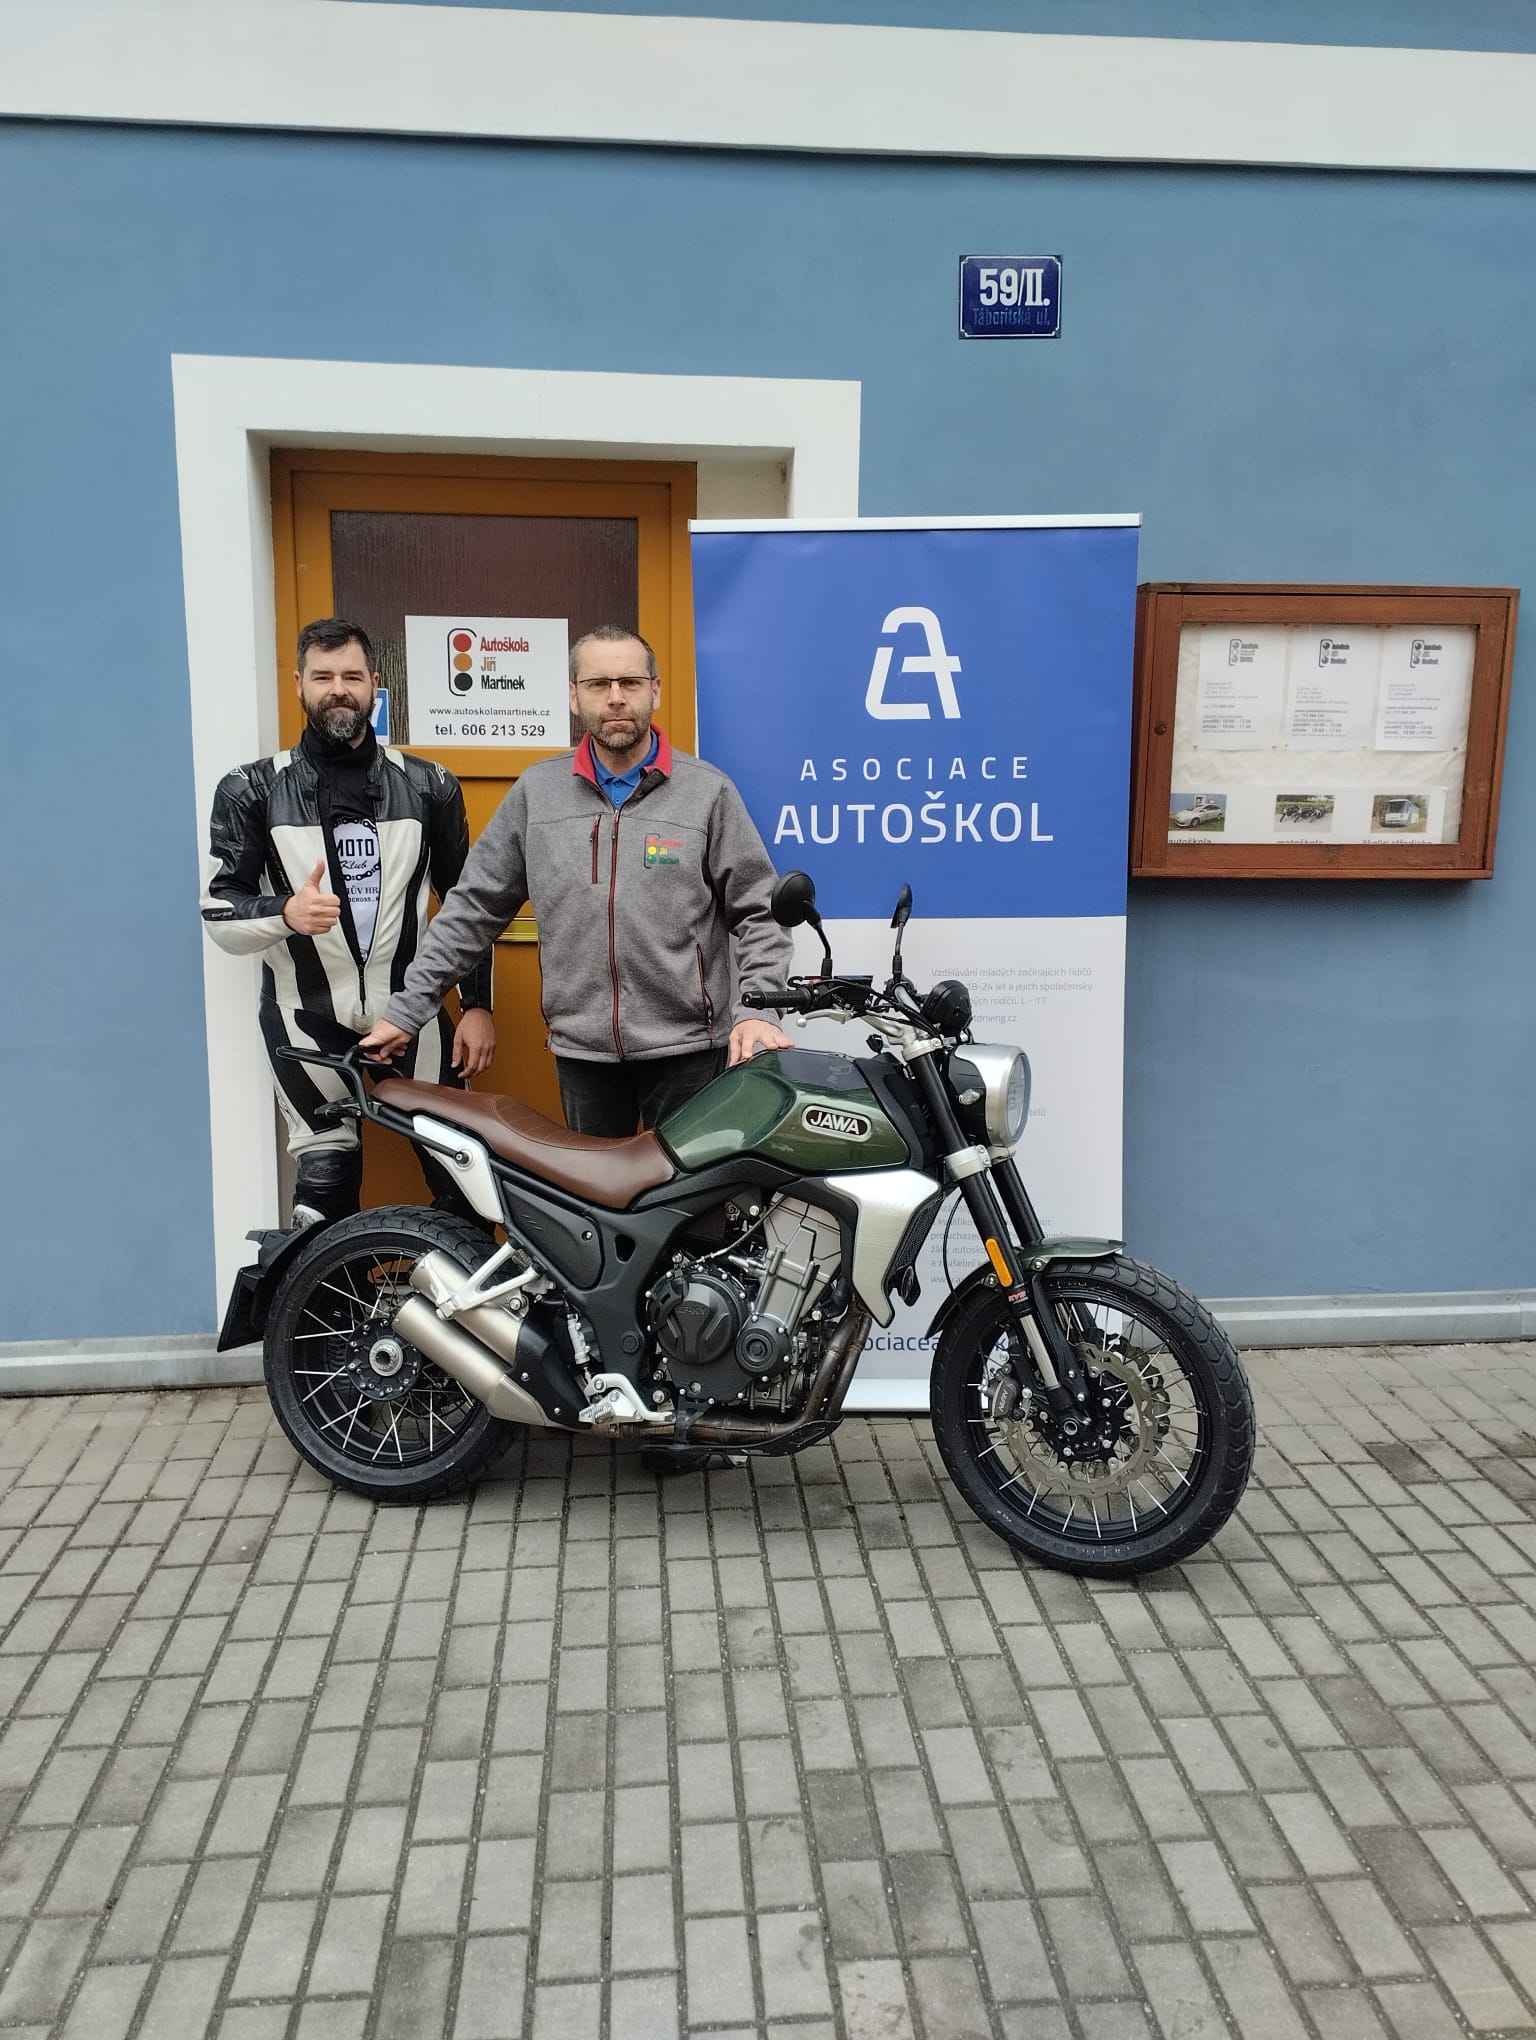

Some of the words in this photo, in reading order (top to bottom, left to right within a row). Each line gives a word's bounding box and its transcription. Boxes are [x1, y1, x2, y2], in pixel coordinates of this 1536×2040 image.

[979, 267, 1051, 306] 59/II.
[480, 636, 529, 653] Autoškola
[480, 656, 497, 672] Jiří
[481, 674, 526, 691] Martínek
[429, 707, 551, 717] www.autoskolamartinek.cz
[435, 724, 457, 736] tel.
[461, 724, 487, 736] 606
[491, 725, 516, 737] 213
[520, 725, 546, 737] 529
[800, 756, 1028, 782] ASOCIACE
[773, 790, 1054, 845] AUTOŠKOL
[931, 967, 978, 977] Vzdělávání
[979, 967, 1016, 979] mladých
[809, 1111, 861, 1136] JAWA
